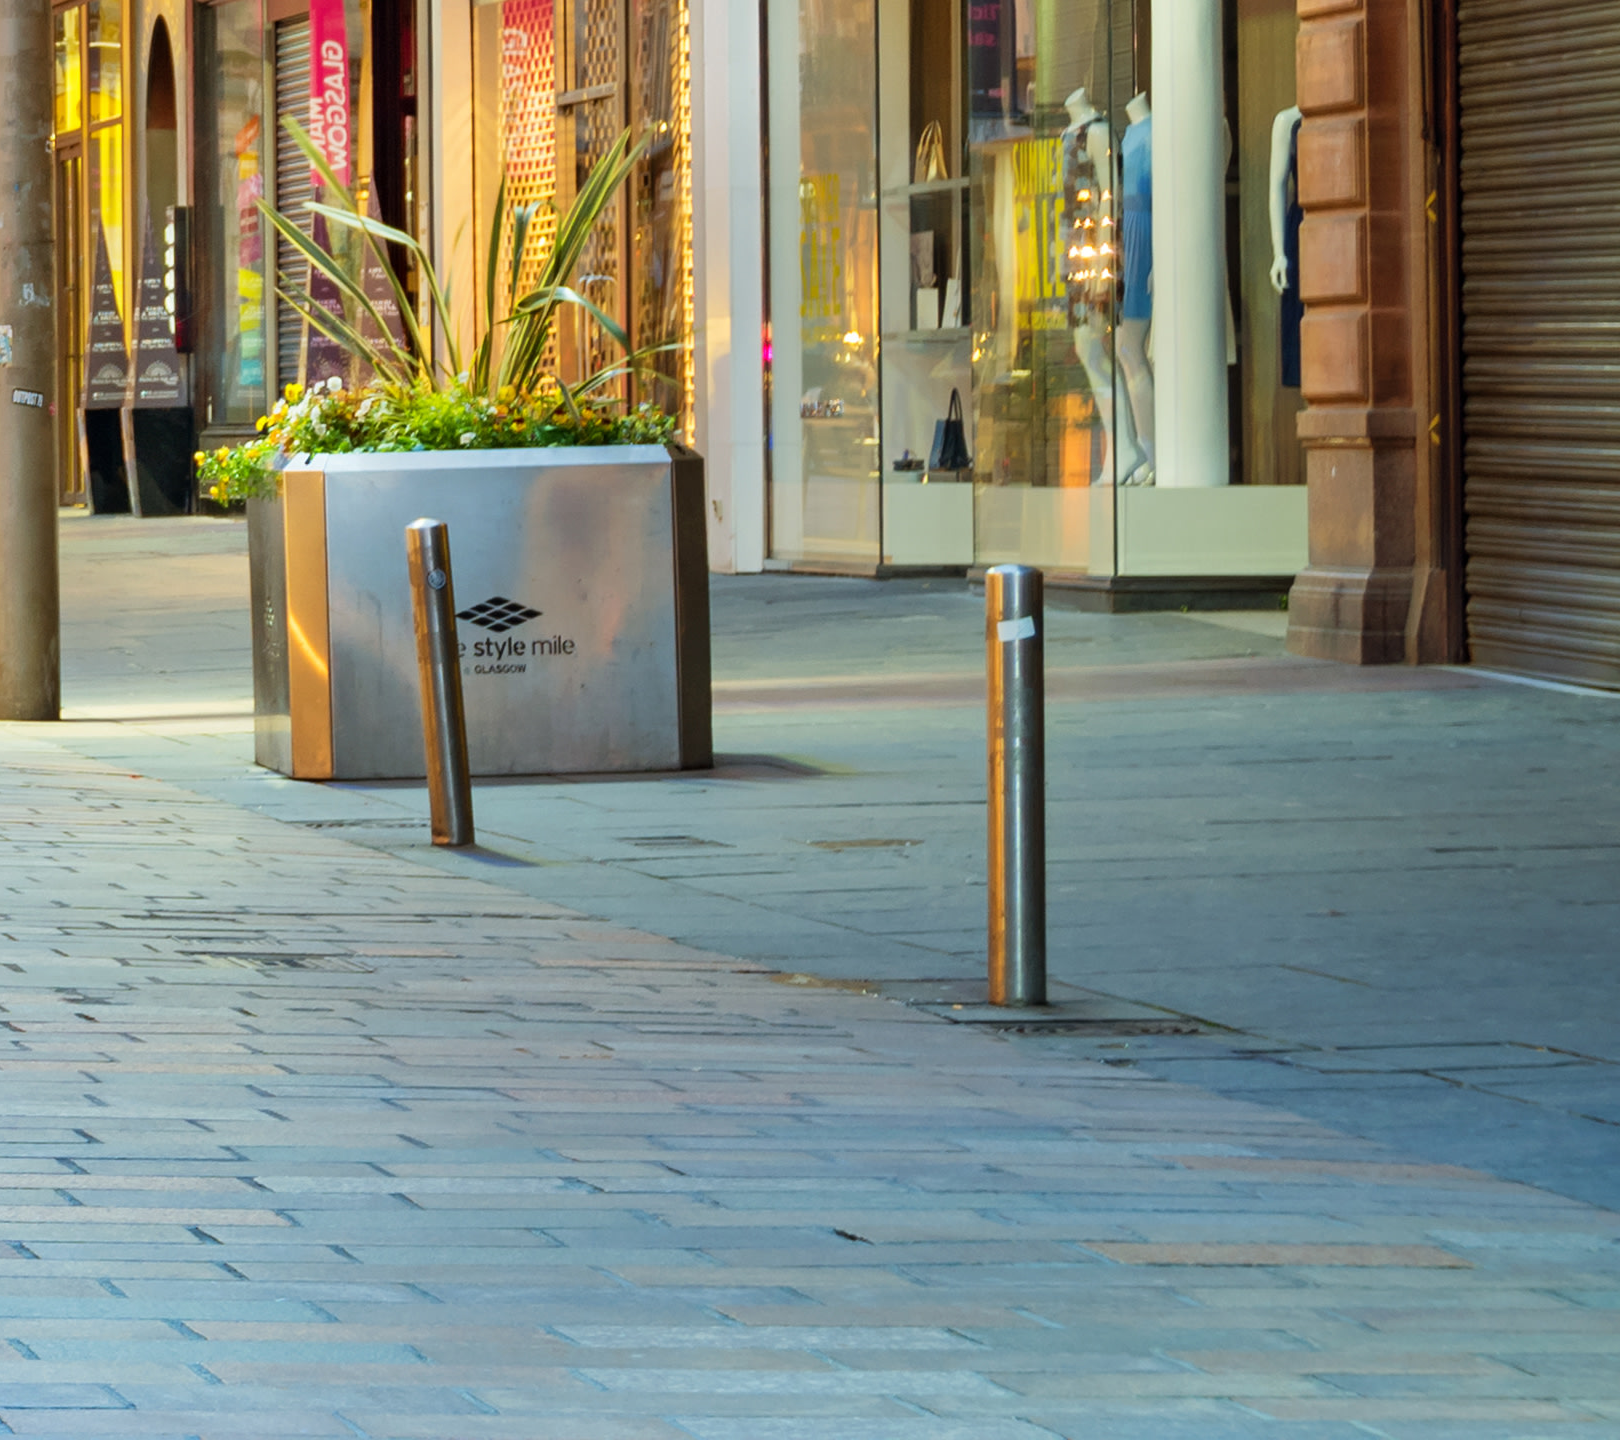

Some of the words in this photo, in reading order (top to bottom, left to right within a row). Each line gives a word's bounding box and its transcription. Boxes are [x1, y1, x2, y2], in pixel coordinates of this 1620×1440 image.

[473, 636, 526, 660] style
[532, 634, 576, 655] mile
[474, 664, 527, 674] GLASGOW
